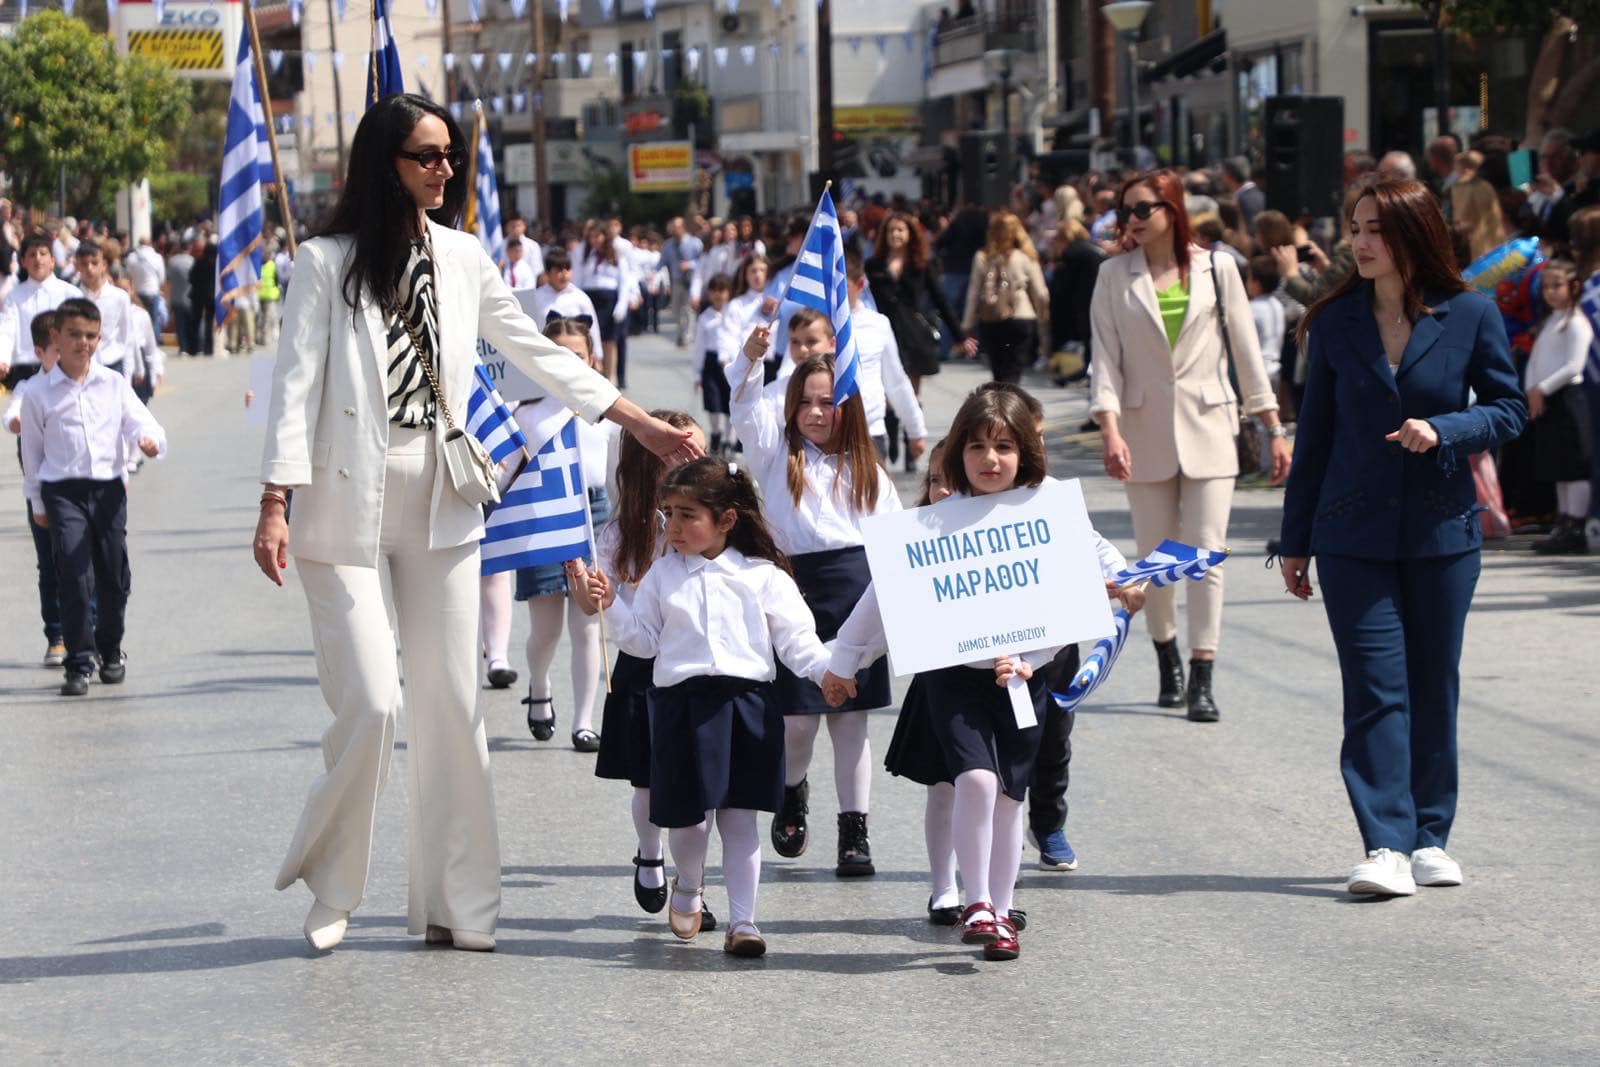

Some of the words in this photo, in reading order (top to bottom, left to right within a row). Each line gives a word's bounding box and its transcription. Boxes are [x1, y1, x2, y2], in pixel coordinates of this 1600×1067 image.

[905, 518, 1051, 568] ΝΗΠΙΑΓΩΓΕΙΟ
[933, 559, 1039, 602] ΜΑΡΑΘΟΥ
[958, 637, 991, 653] ΔΗΜΟΣ
[992, 626, 1047, 646] ΜΑΛΕΒΙΖΙΟΥ
